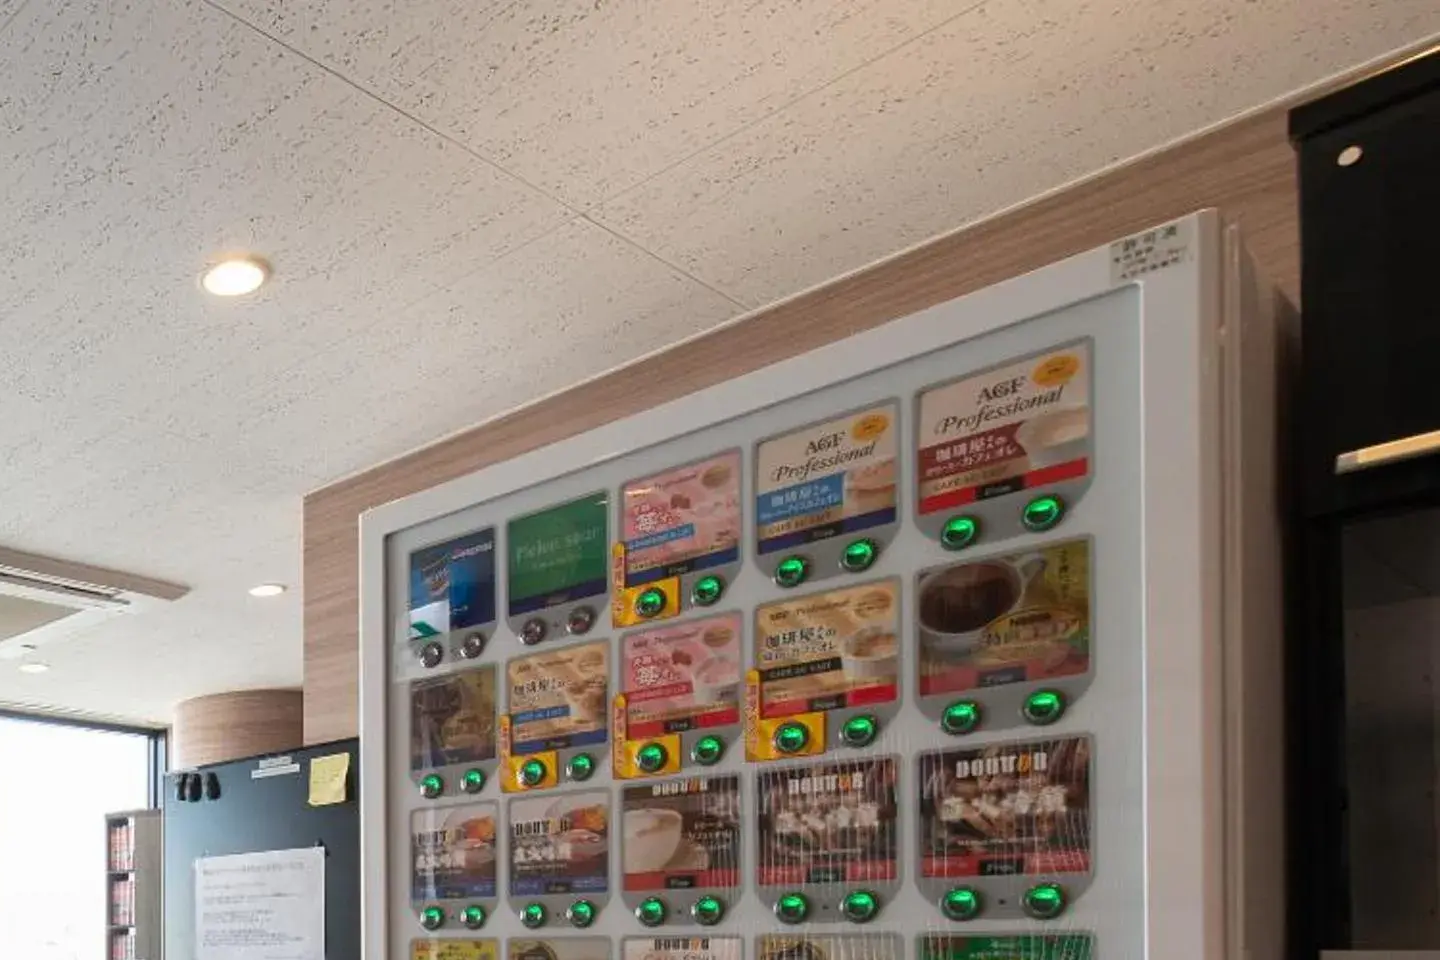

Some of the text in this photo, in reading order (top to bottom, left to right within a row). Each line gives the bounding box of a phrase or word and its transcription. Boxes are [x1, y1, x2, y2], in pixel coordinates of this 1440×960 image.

[934, 386, 1064, 435] Professional
[976, 375, 1028, 405] AGF
[771, 441, 876, 482] Professional
